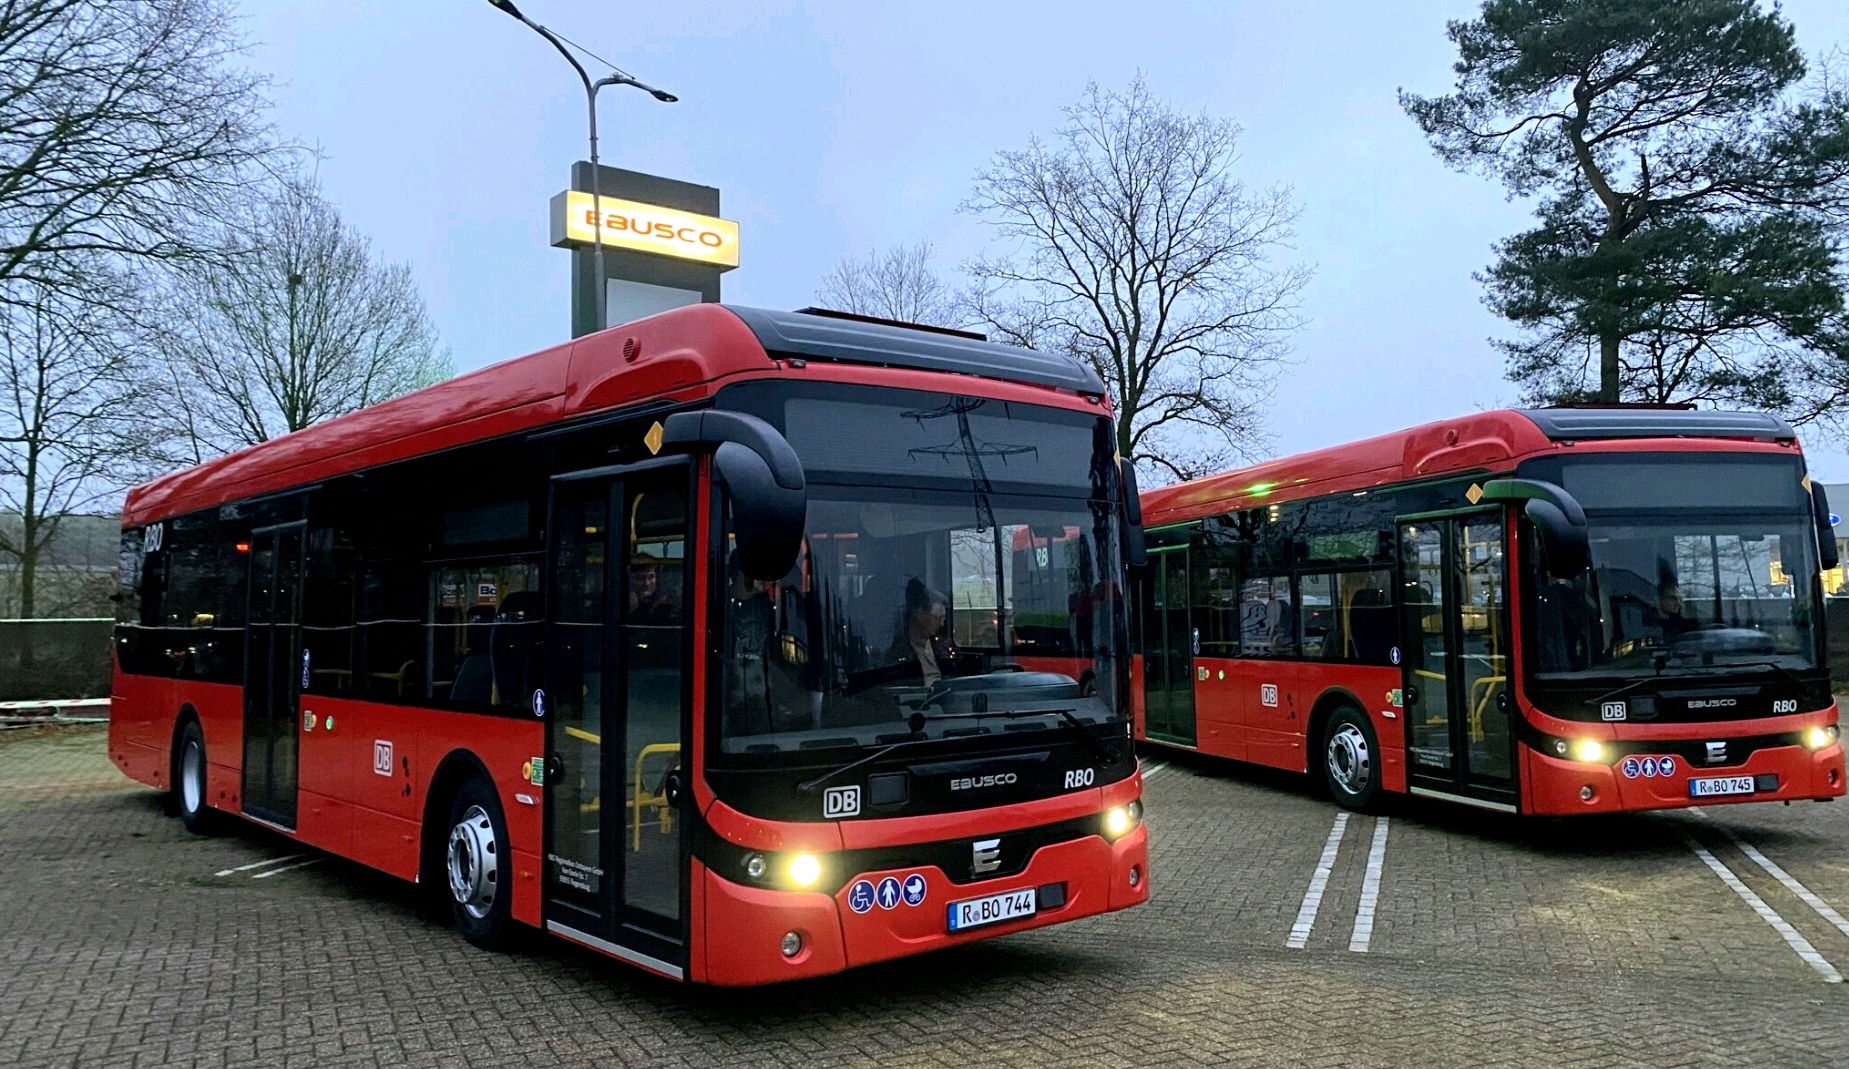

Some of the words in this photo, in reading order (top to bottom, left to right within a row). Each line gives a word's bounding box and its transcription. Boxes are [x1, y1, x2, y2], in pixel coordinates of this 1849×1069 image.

[585, 209, 722, 248] EBUSCO
[142, 522, 164, 553] RBO
[1604, 704, 1624, 719] DB
[1687, 698, 1738, 709] EBUSCO
[1772, 699, 1798, 714] RBO
[375, 744, 391, 771] DB
[949, 772, 1018, 791] EBUSCO
[1063, 767, 1095, 789] RBO
[1713, 780, 1728, 793] BO
[1730, 779, 1751, 792] 745
[827, 789, 857, 814] DB
[962, 904, 973, 925] R
[981, 899, 1001, 921] BO
[1004, 892, 1031, 915] 744
